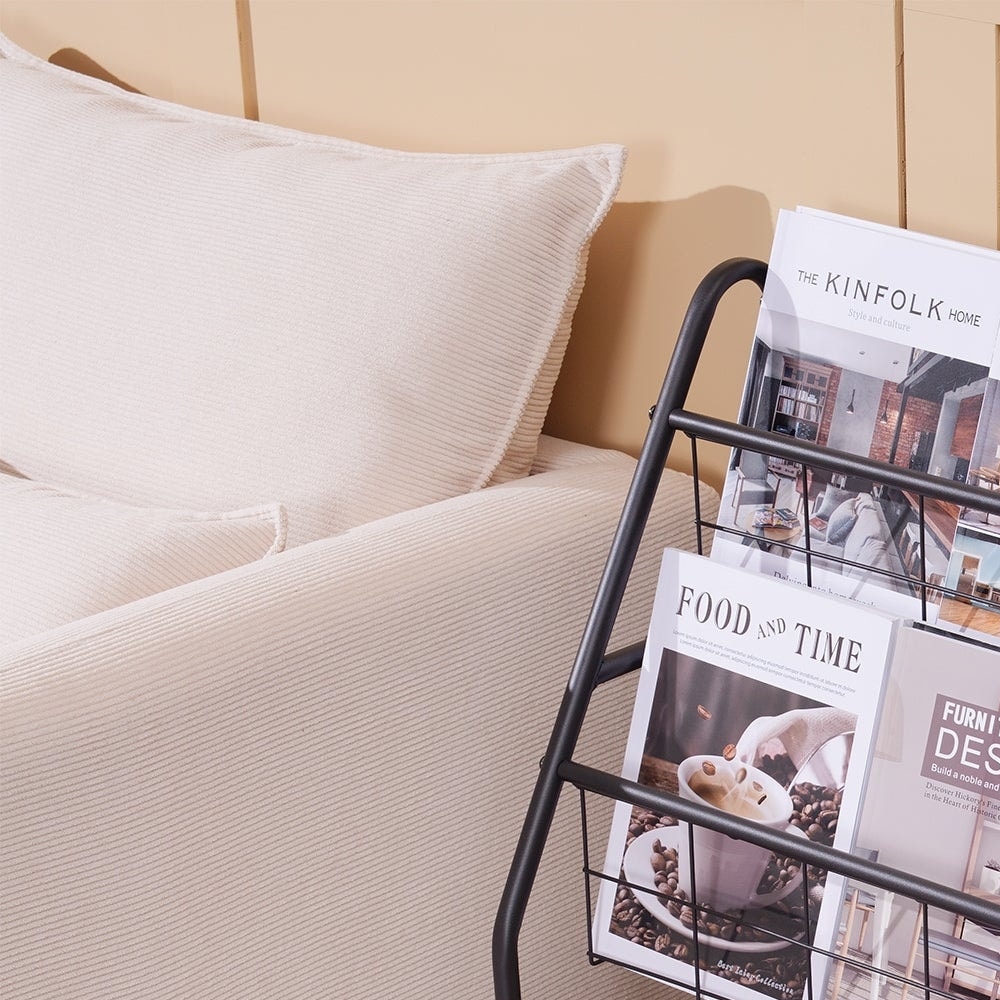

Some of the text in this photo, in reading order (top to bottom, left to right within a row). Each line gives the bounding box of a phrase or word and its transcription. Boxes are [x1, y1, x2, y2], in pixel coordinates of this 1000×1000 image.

[798, 270, 982, 327] THE KINFOLK HOME
[848, 308, 911, 332] Style and culture
[676, 585, 751, 636] FOOD
[757, 618, 786, 640] AND
[794, 622, 863, 674] TIME
[926, 782, 954, 797] Discover
[931, 763, 952, 778] Build
[953, 771, 959, 779] a
[959, 772, 983, 787] noble
[984, 780, 1000, 792] and
[931, 793, 942, 802] the
[942, 796, 961, 809] Heart
[962, 803, 970, 811] of
[970, 805, 997, 820] Historic
